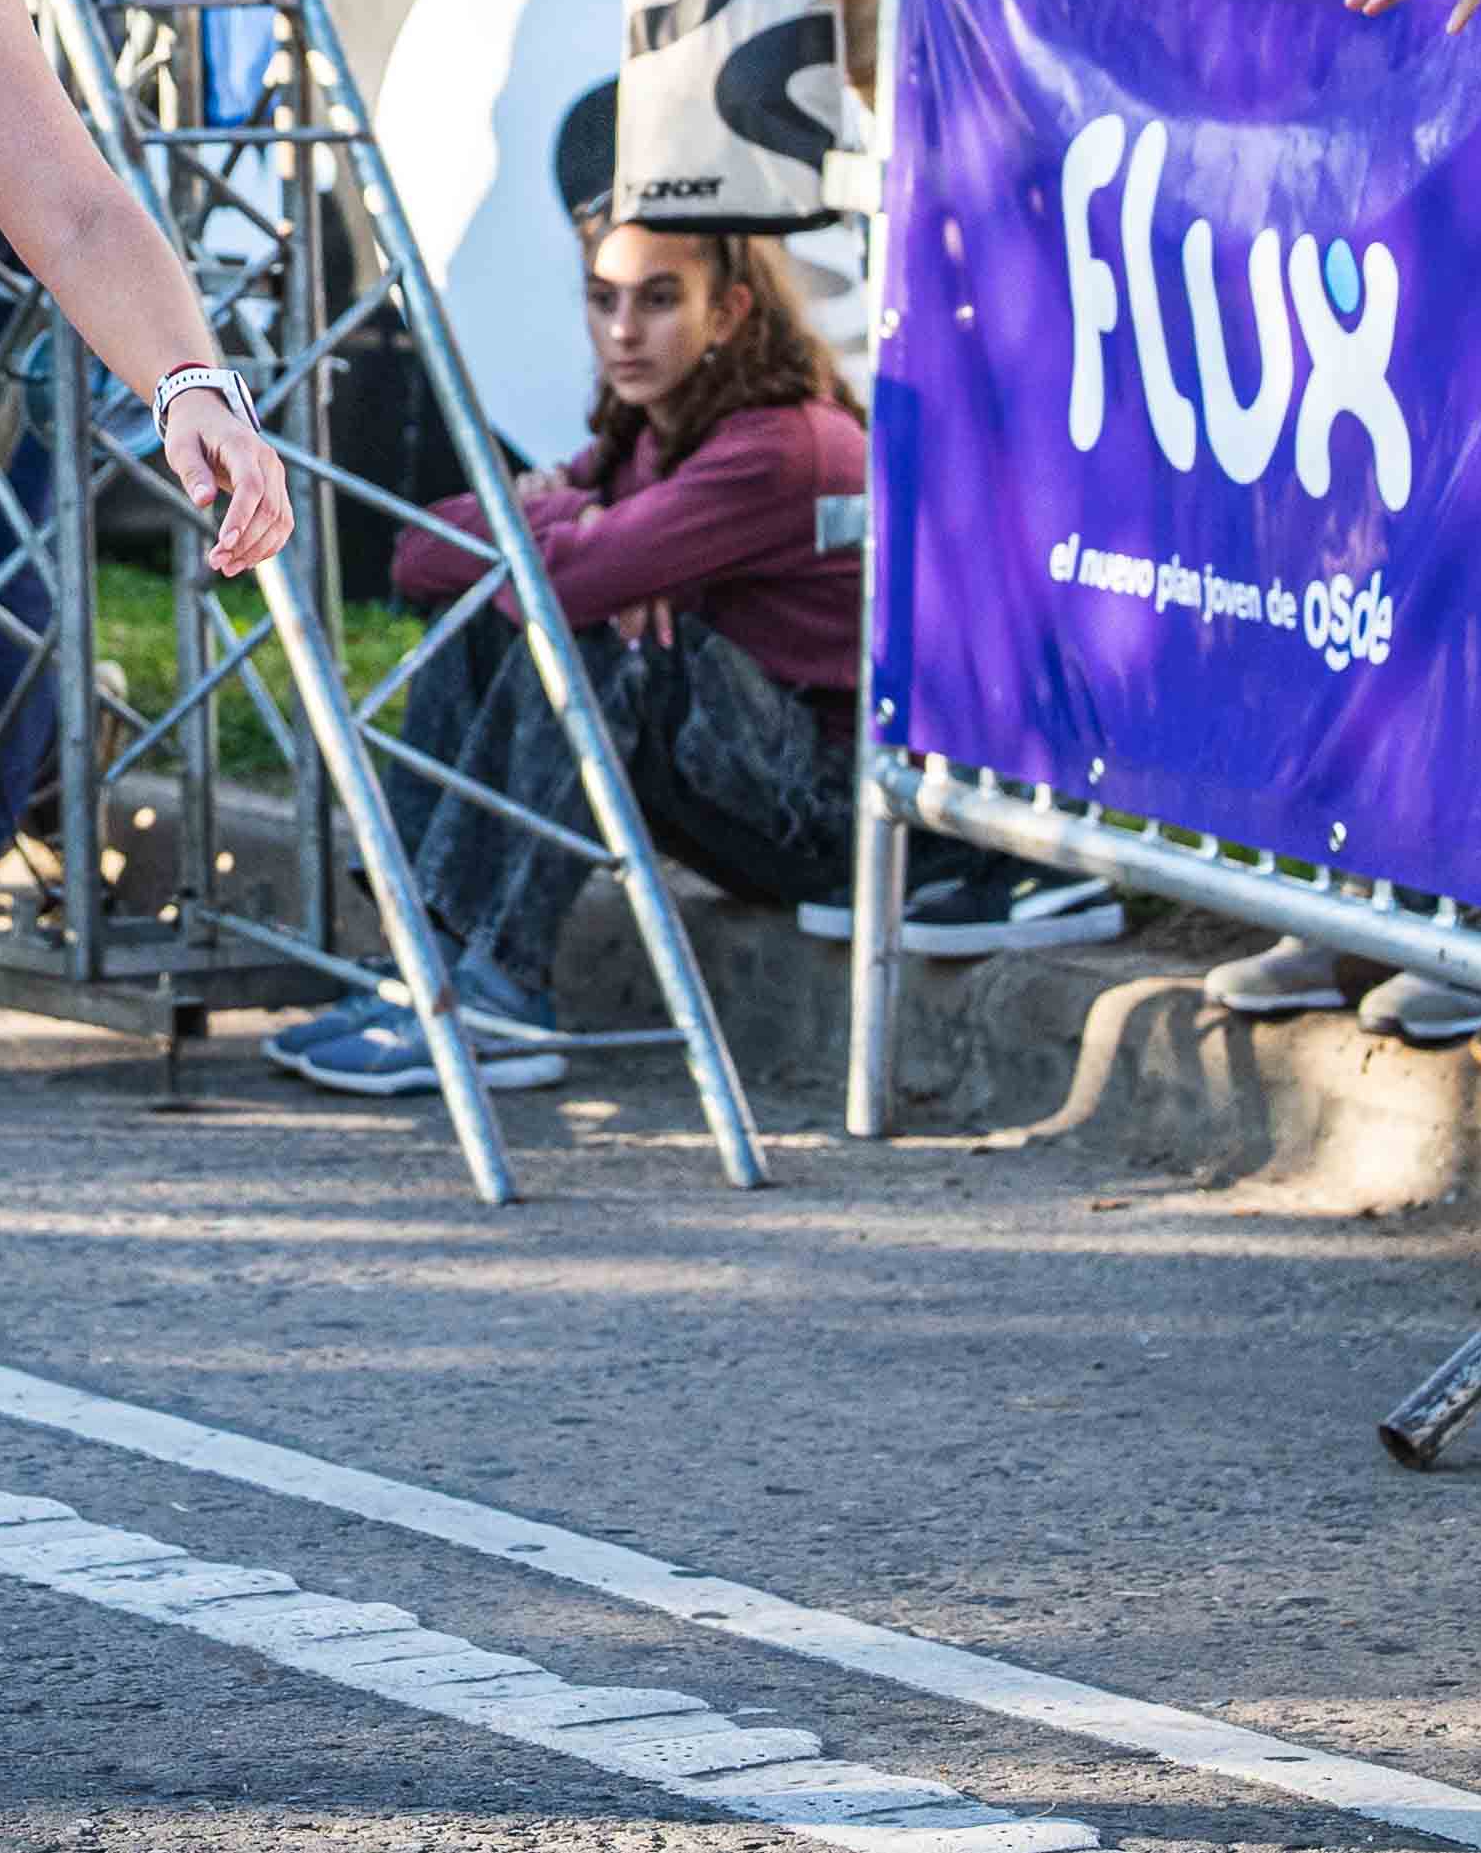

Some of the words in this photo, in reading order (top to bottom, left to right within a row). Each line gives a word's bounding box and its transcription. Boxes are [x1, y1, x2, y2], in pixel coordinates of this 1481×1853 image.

[1049, 532, 1079, 583] el
[1081, 546, 1155, 599] nuevo
[1157, 552, 1201, 614] plan
[1204, 564, 1261, 625] joven
[1265, 578, 1298, 632] de
[1303, 570, 1393, 670] osde
